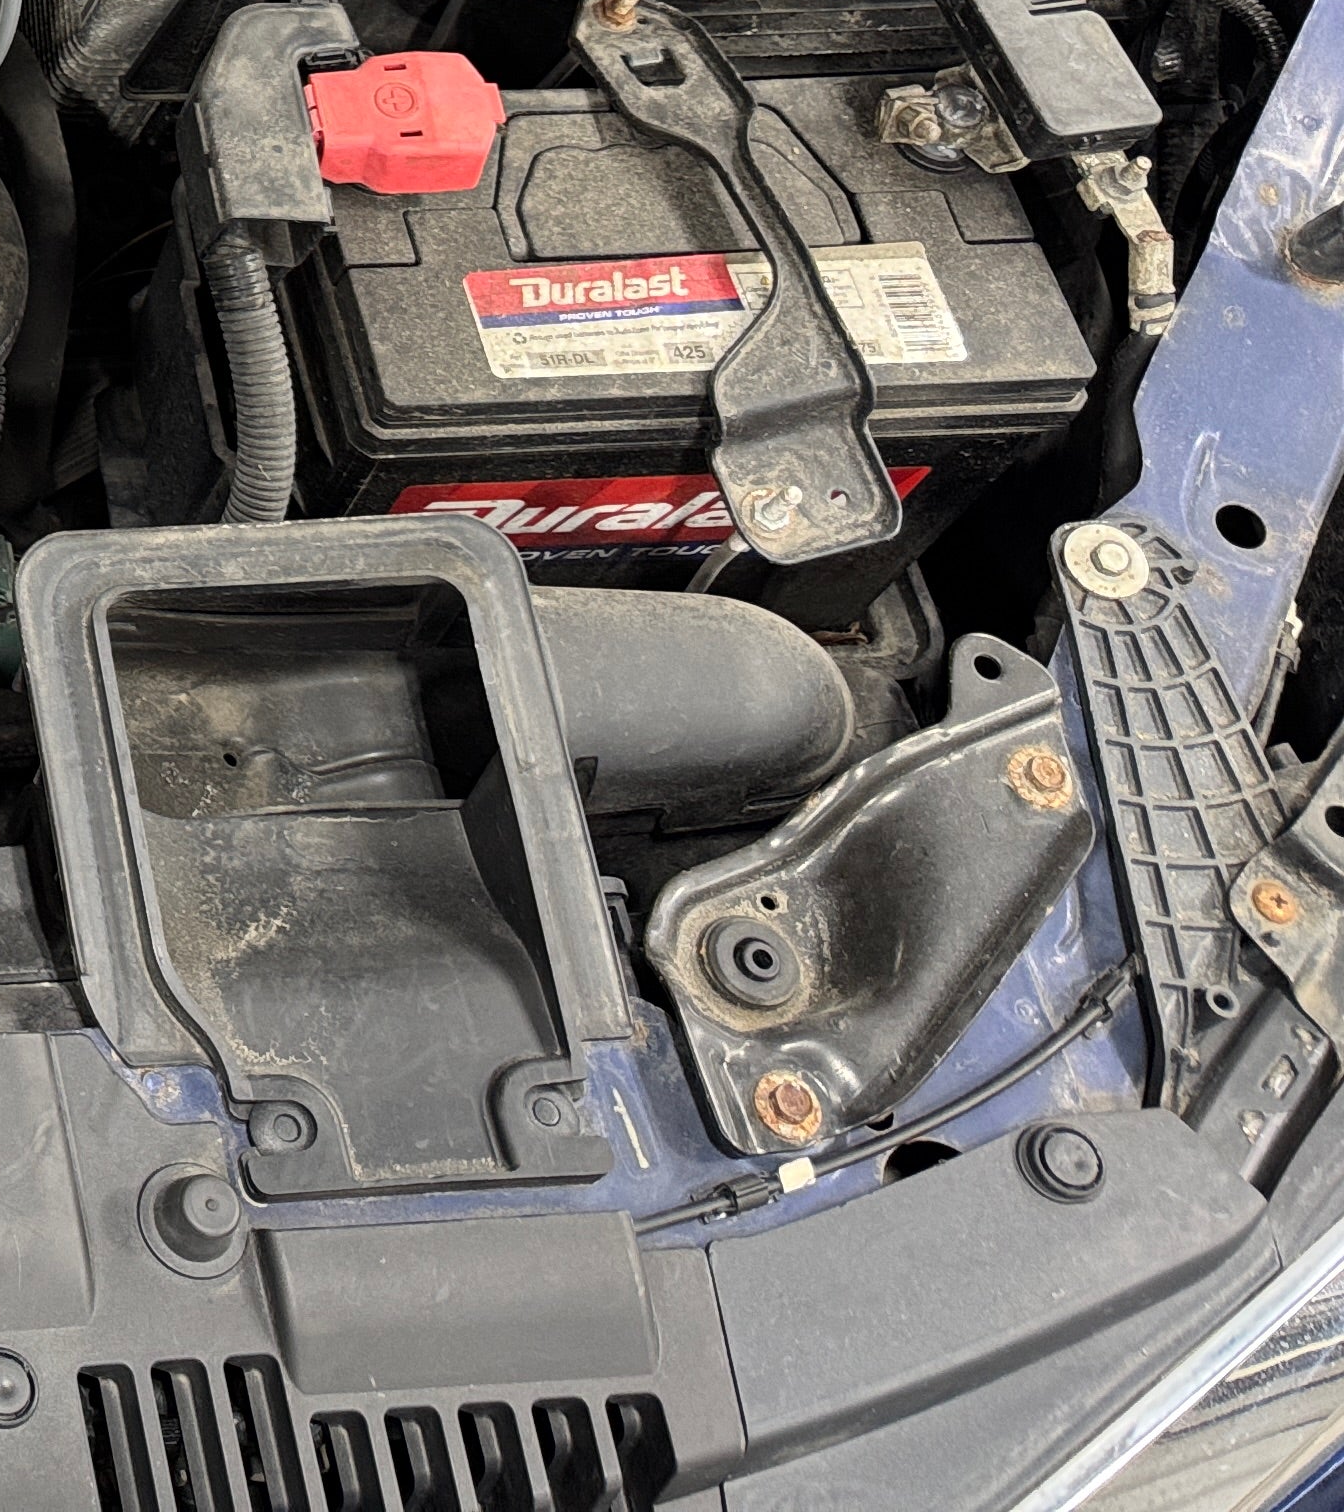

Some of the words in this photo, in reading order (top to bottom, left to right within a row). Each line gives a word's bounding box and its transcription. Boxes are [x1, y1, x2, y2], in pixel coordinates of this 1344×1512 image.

[509, 266, 689, 308] Duralast
[559, 309, 612, 322] PROVEN
[614, 306, 660, 318] TOUGH
[673, 345, 707, 360] 425
[424, 491, 734, 534] Durala
[520, 547, 615, 562] OVEN
[632, 544, 722, 557] TOU
